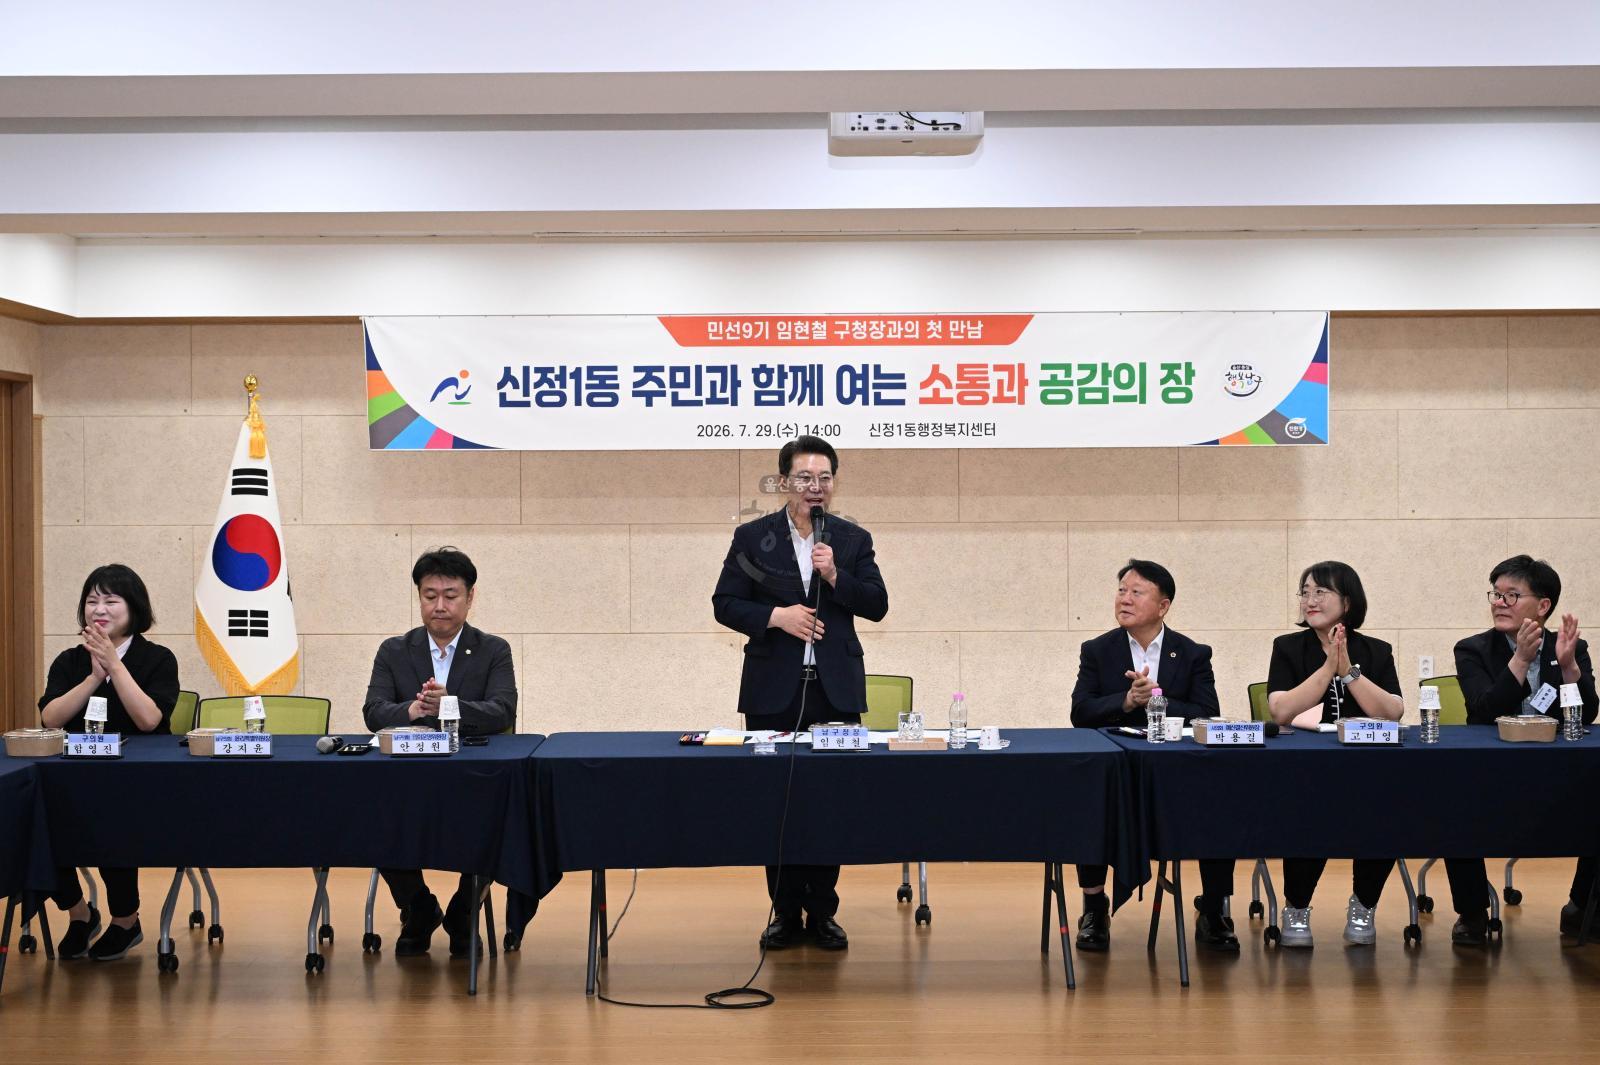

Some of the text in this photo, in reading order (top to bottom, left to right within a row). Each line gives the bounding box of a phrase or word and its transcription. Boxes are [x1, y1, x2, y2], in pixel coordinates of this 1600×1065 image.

[707, 319, 984, 341] 민선9기 임현철 구청장과의 첫 만남
[496, 361, 1196, 408] 신정1동 주민과 함께 여는 소통과 공감의 장
[697, 423, 841, 438] 2026. 7. 29.(수) 14:00
[868, 422, 996, 437] 신정1동행정복지센터
[1359, 722, 1383, 730] 구의원
[82, 734, 105, 743] 구의원
